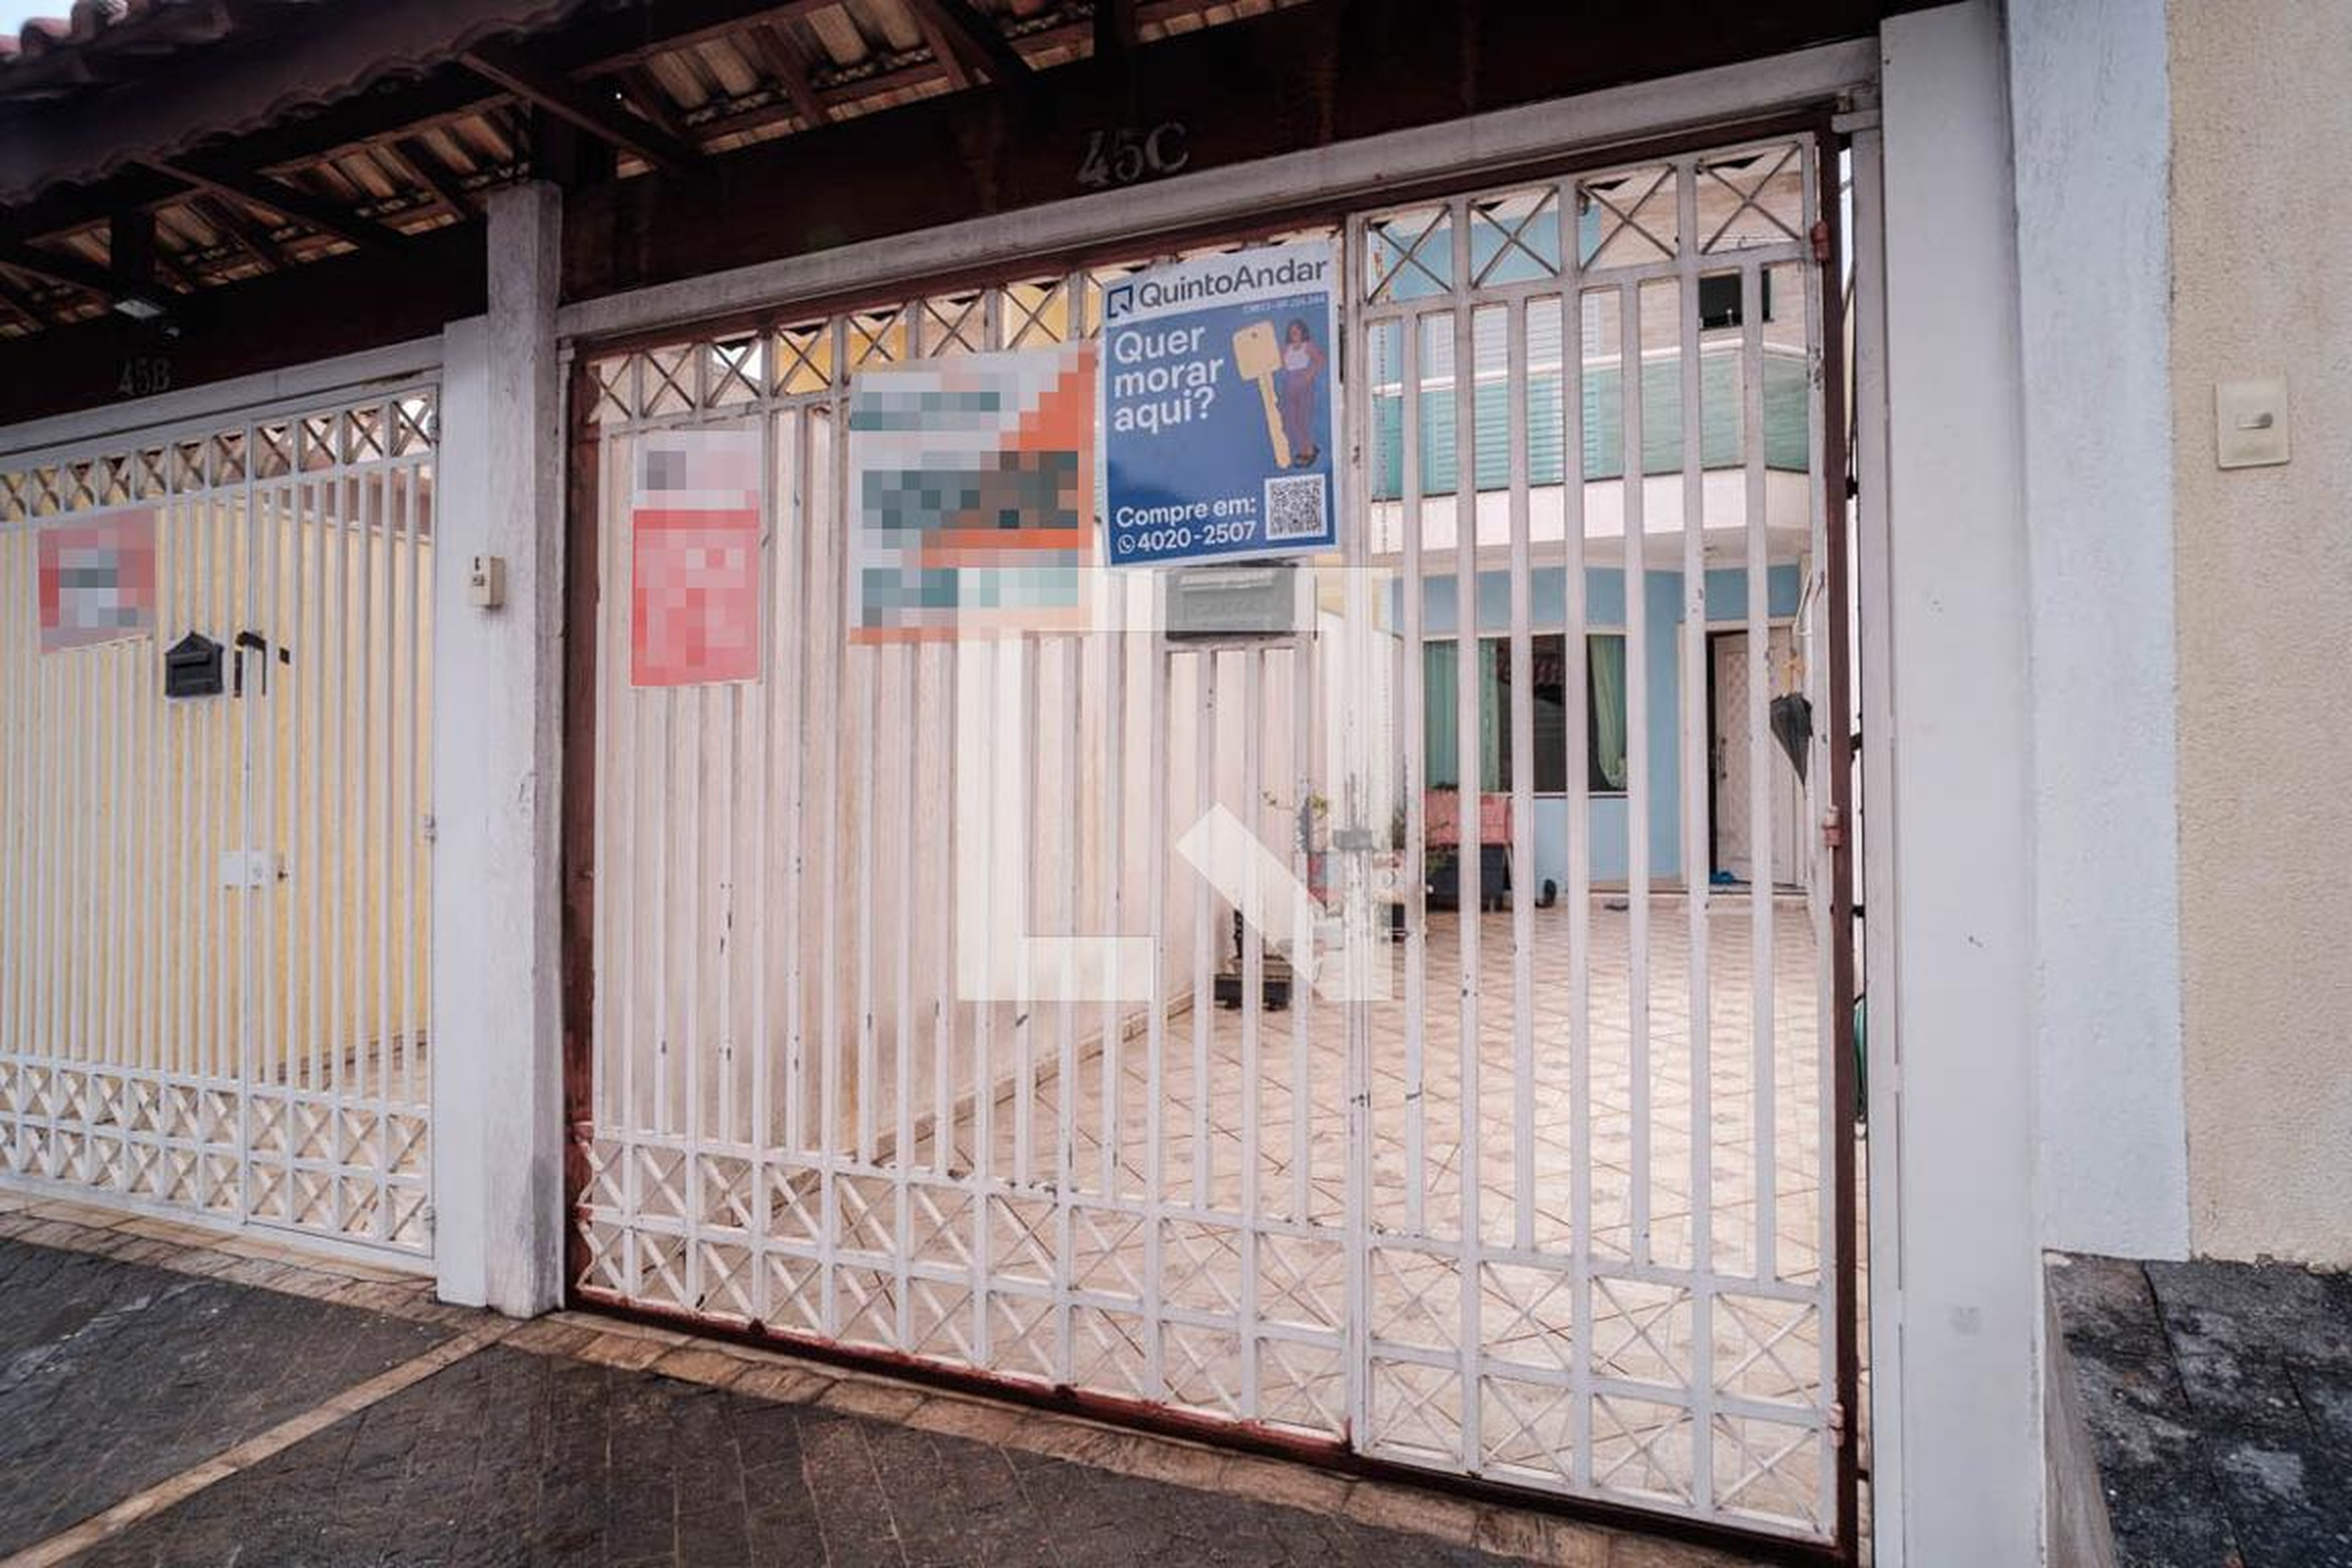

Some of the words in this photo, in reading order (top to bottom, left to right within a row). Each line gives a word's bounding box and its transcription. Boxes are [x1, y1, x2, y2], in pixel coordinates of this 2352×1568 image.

[1077, 123, 1189, 186] 45C
[1139, 259, 1327, 307] QuintoAndar
[1114, 326, 1205, 363] Quer
[1115, 358, 1224, 398] morar
[1114, 387, 1214, 434] aqui?
[1116, 502, 1208, 527] Compre
[1213, 496, 1256, 514] em:
[1137, 522, 1256, 551] 4020-2507
